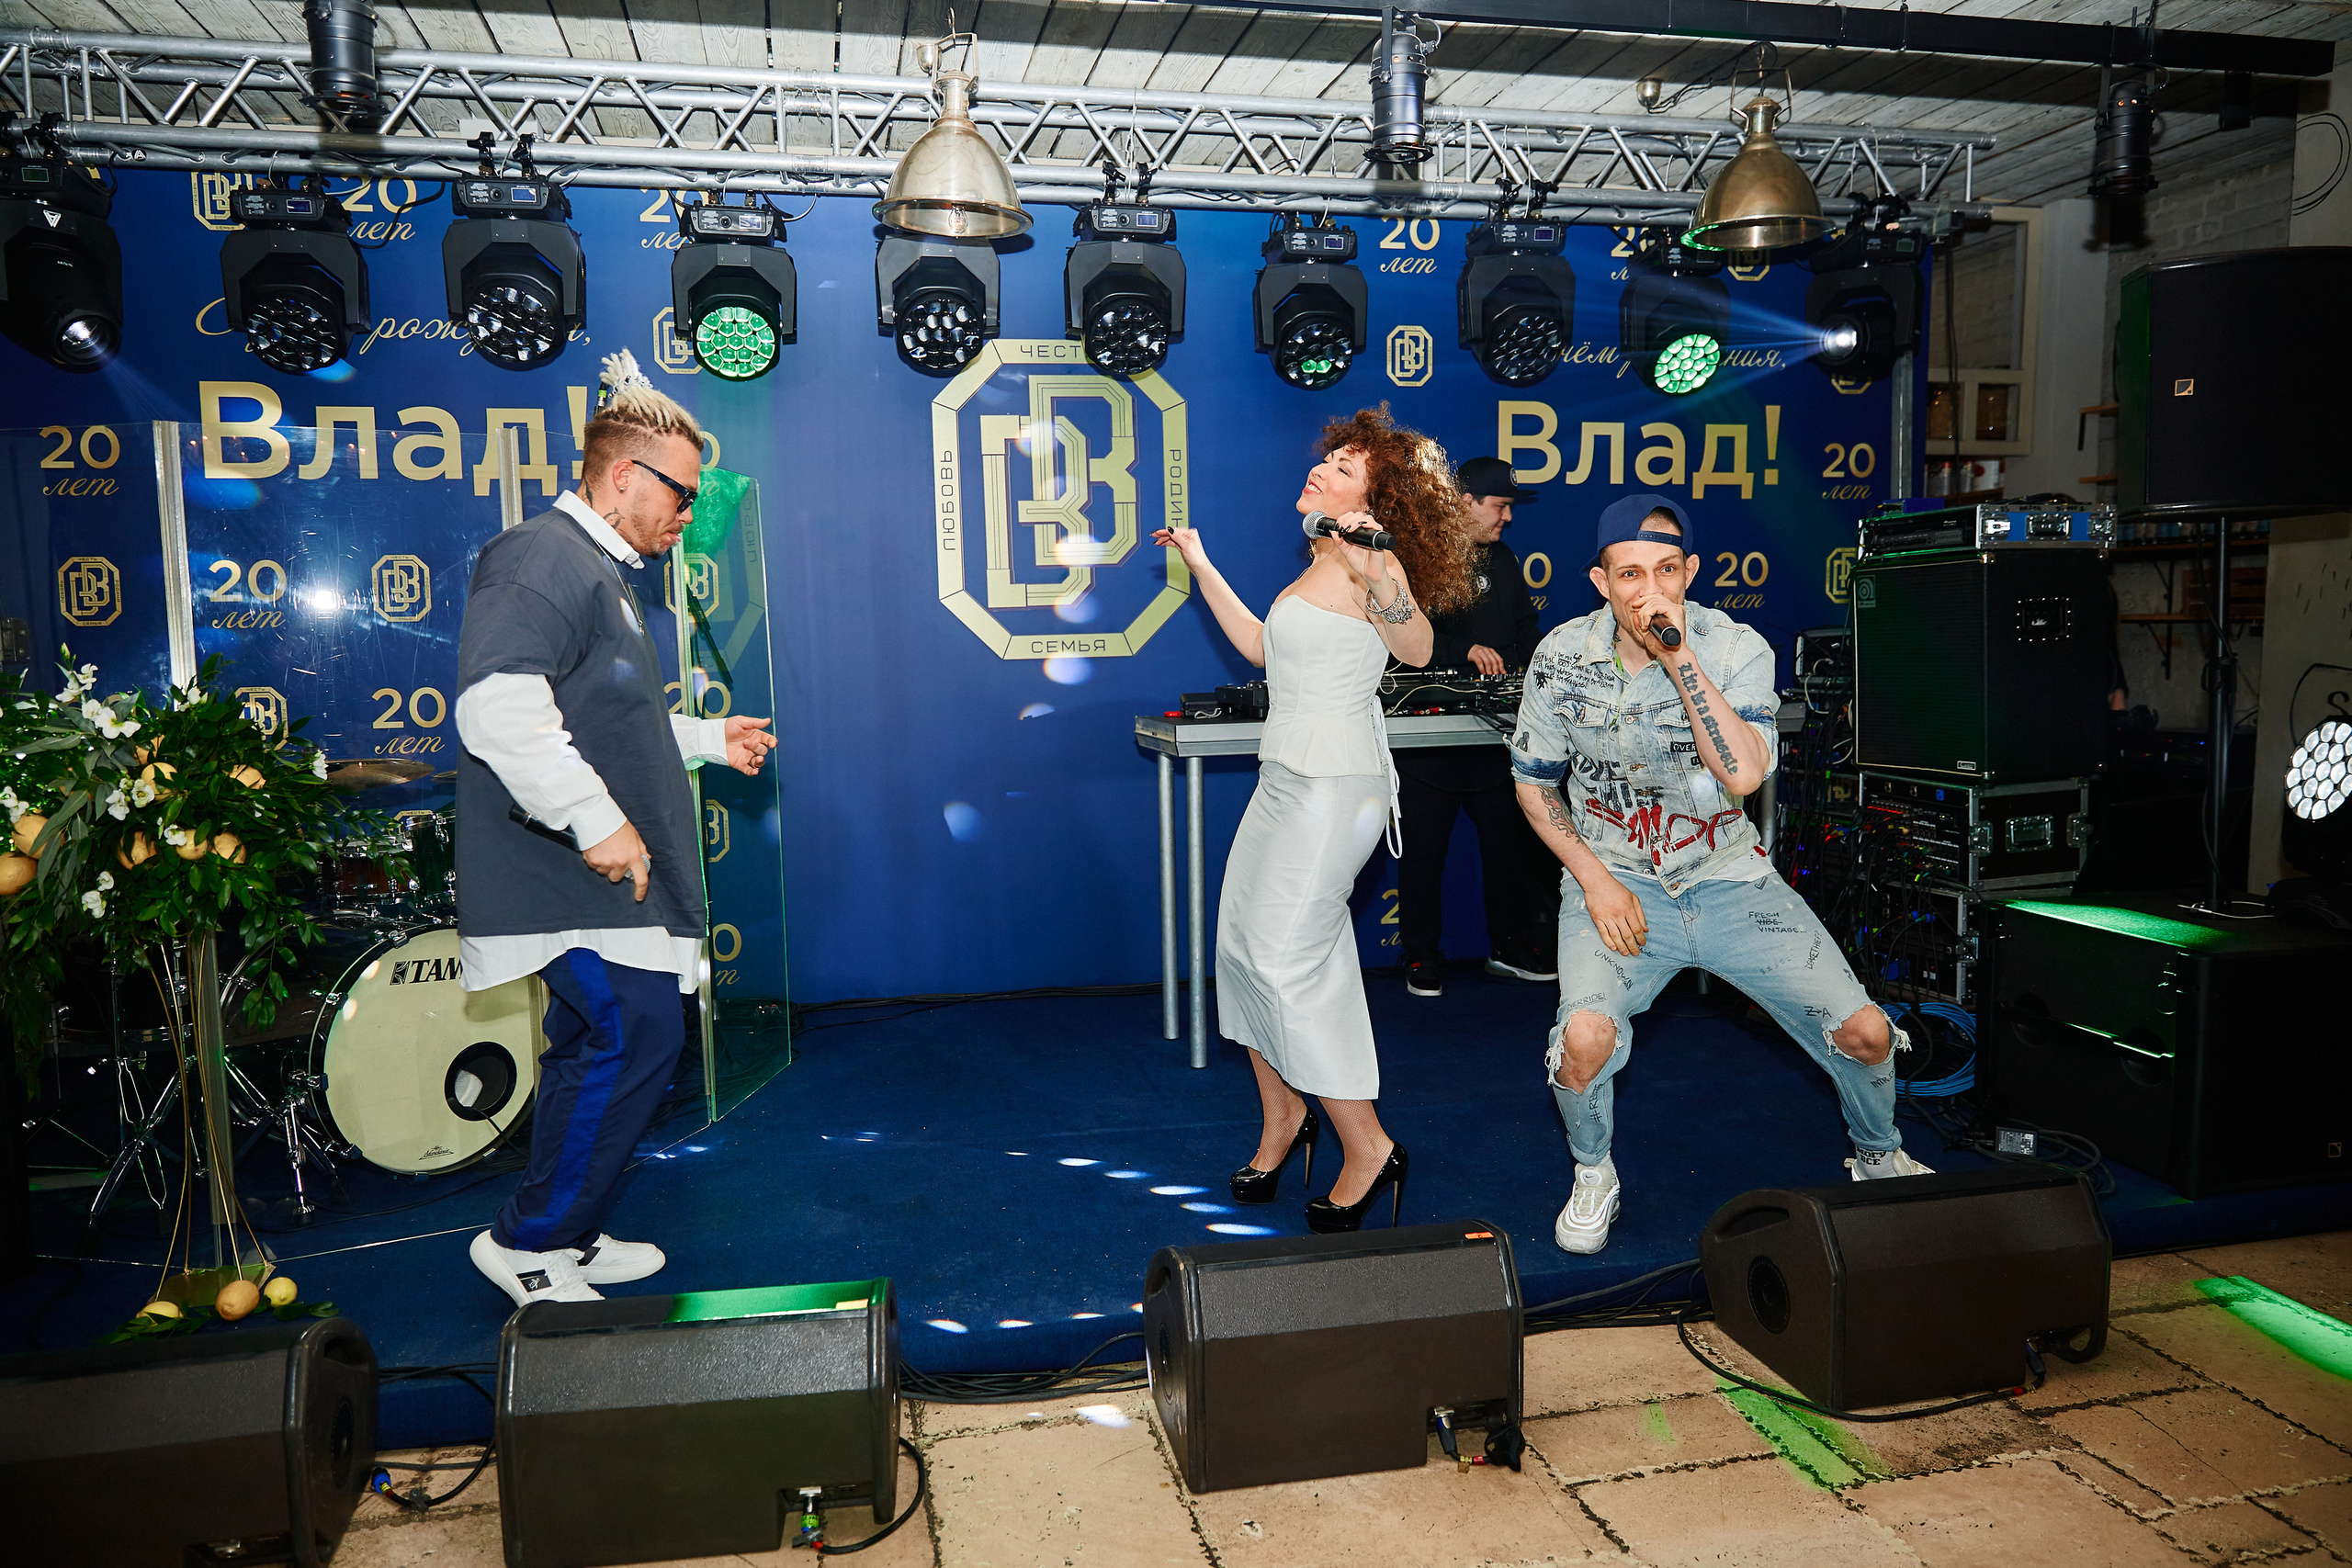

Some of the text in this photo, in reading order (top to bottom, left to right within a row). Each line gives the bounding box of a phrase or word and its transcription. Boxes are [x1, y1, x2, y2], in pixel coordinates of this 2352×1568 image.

[340, 174, 417, 214] 20
[1380, 214, 1441, 251] 20
[1380, 256, 1438, 275] лет
[1020, 344, 1082, 358] ЧЕСТ
[39, 425, 120, 469] 20
[198, 379, 589, 497] Влад!
[1498, 400, 1781, 500] Влад!
[1823, 443, 1876, 478] 20
[42, 478, 119, 497] лет
[940, 450, 956, 551] ЛЮБОВЬ
[1169, 449, 1183, 529] РОДИН
[1821, 483, 1872, 501] лет
[208, 559, 288, 604] 20
[1714, 551, 1770, 588] 20
[1713, 592, 1766, 609] лет
[211, 609, 288, 630] лет
[1030, 639, 1106, 654] СЕМЬЯ
[372, 686, 447, 730] 20
[374, 735, 447, 755] лет
[1748, 910, 1780, 919] FRESH
[409, 957, 461, 984] TAM
